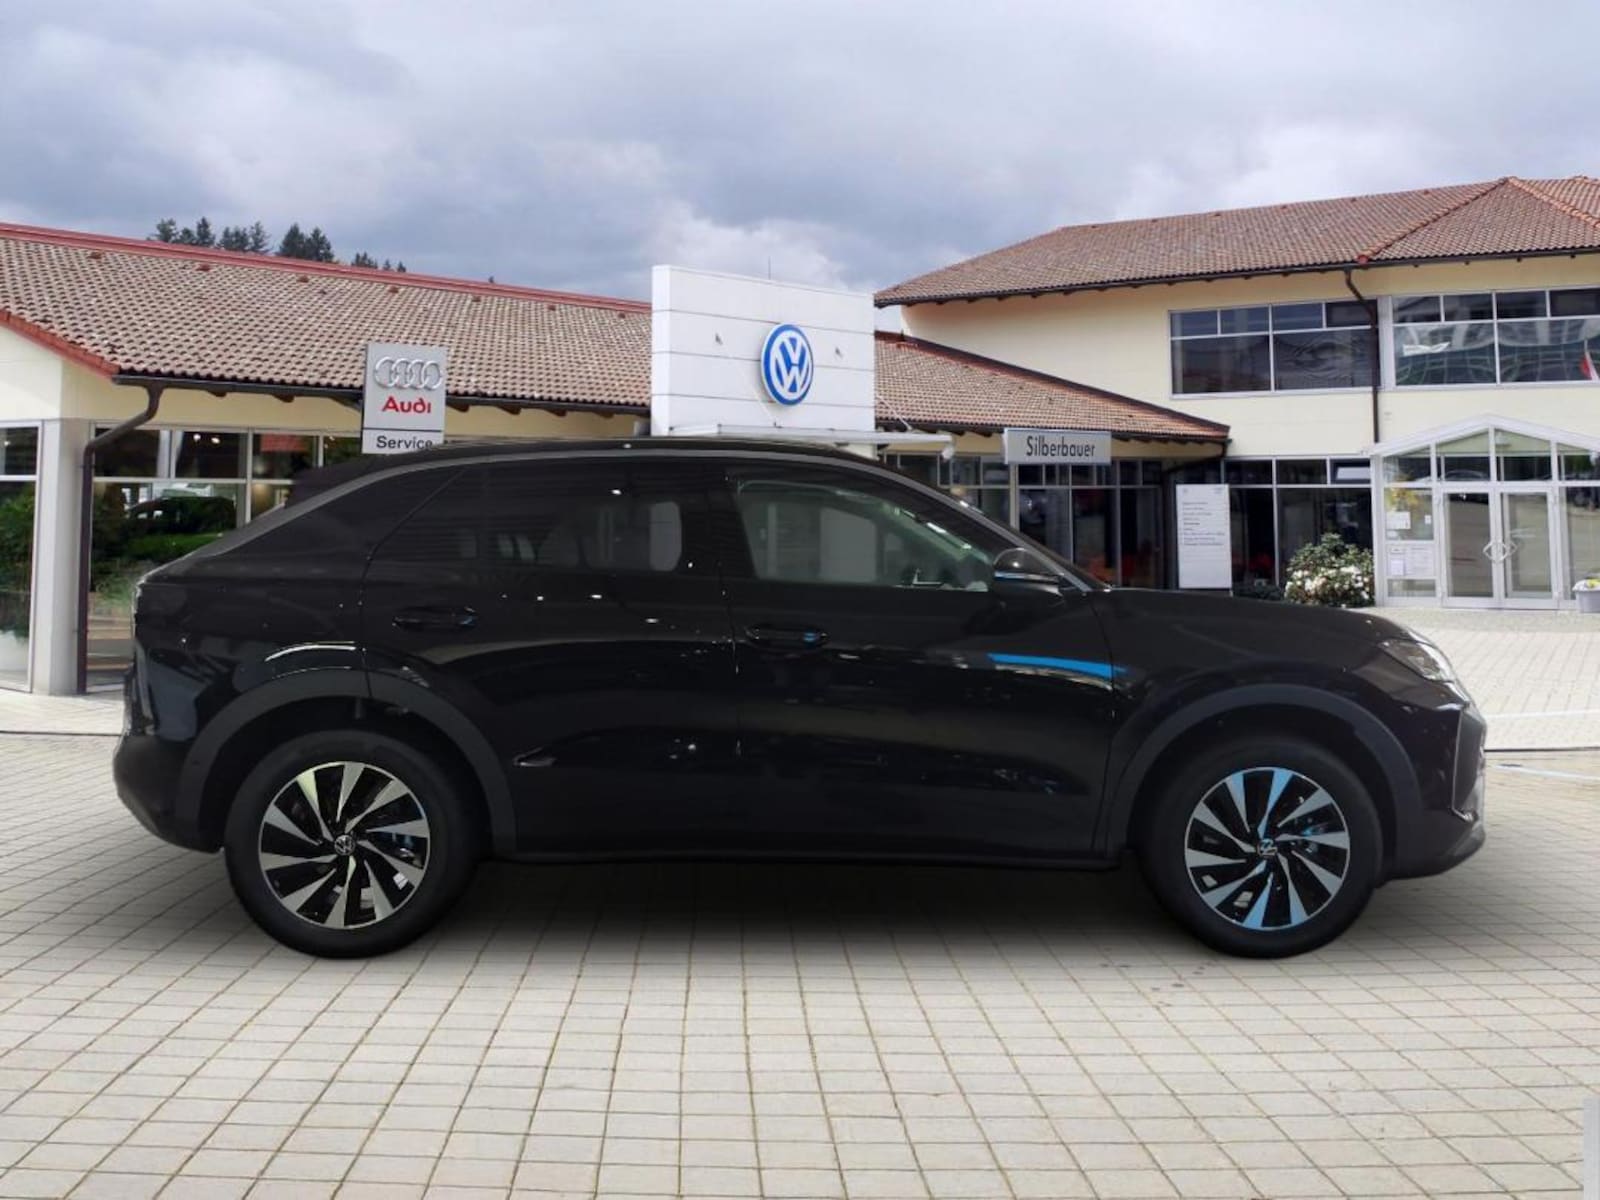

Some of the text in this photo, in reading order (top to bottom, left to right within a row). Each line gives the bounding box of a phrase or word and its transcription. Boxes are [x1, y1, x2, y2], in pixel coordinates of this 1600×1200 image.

[382, 396, 431, 413] Audi
[376, 435, 433, 449] Service
[1026, 435, 1096, 457] Silberbauer
